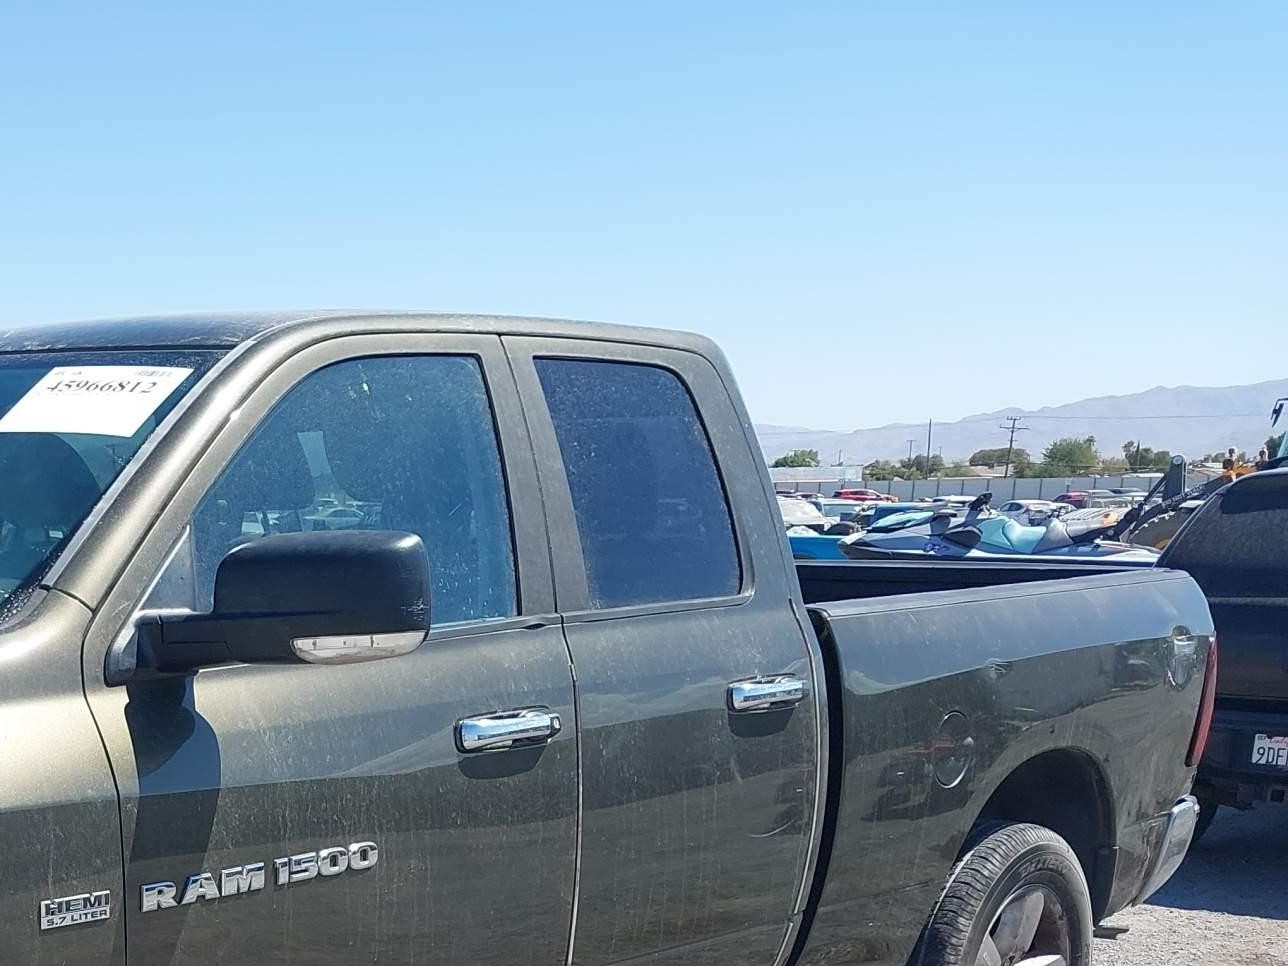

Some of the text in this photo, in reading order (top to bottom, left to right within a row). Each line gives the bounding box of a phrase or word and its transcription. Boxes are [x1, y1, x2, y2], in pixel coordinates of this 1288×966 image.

[46, 379, 158, 394] 45966812
[1255, 746, 1288, 764] 9DF
[140, 841, 379, 912] RAM 1500
[41, 890, 111, 917] HEMI
[47, 909, 108, 927] 5.7 LITER
